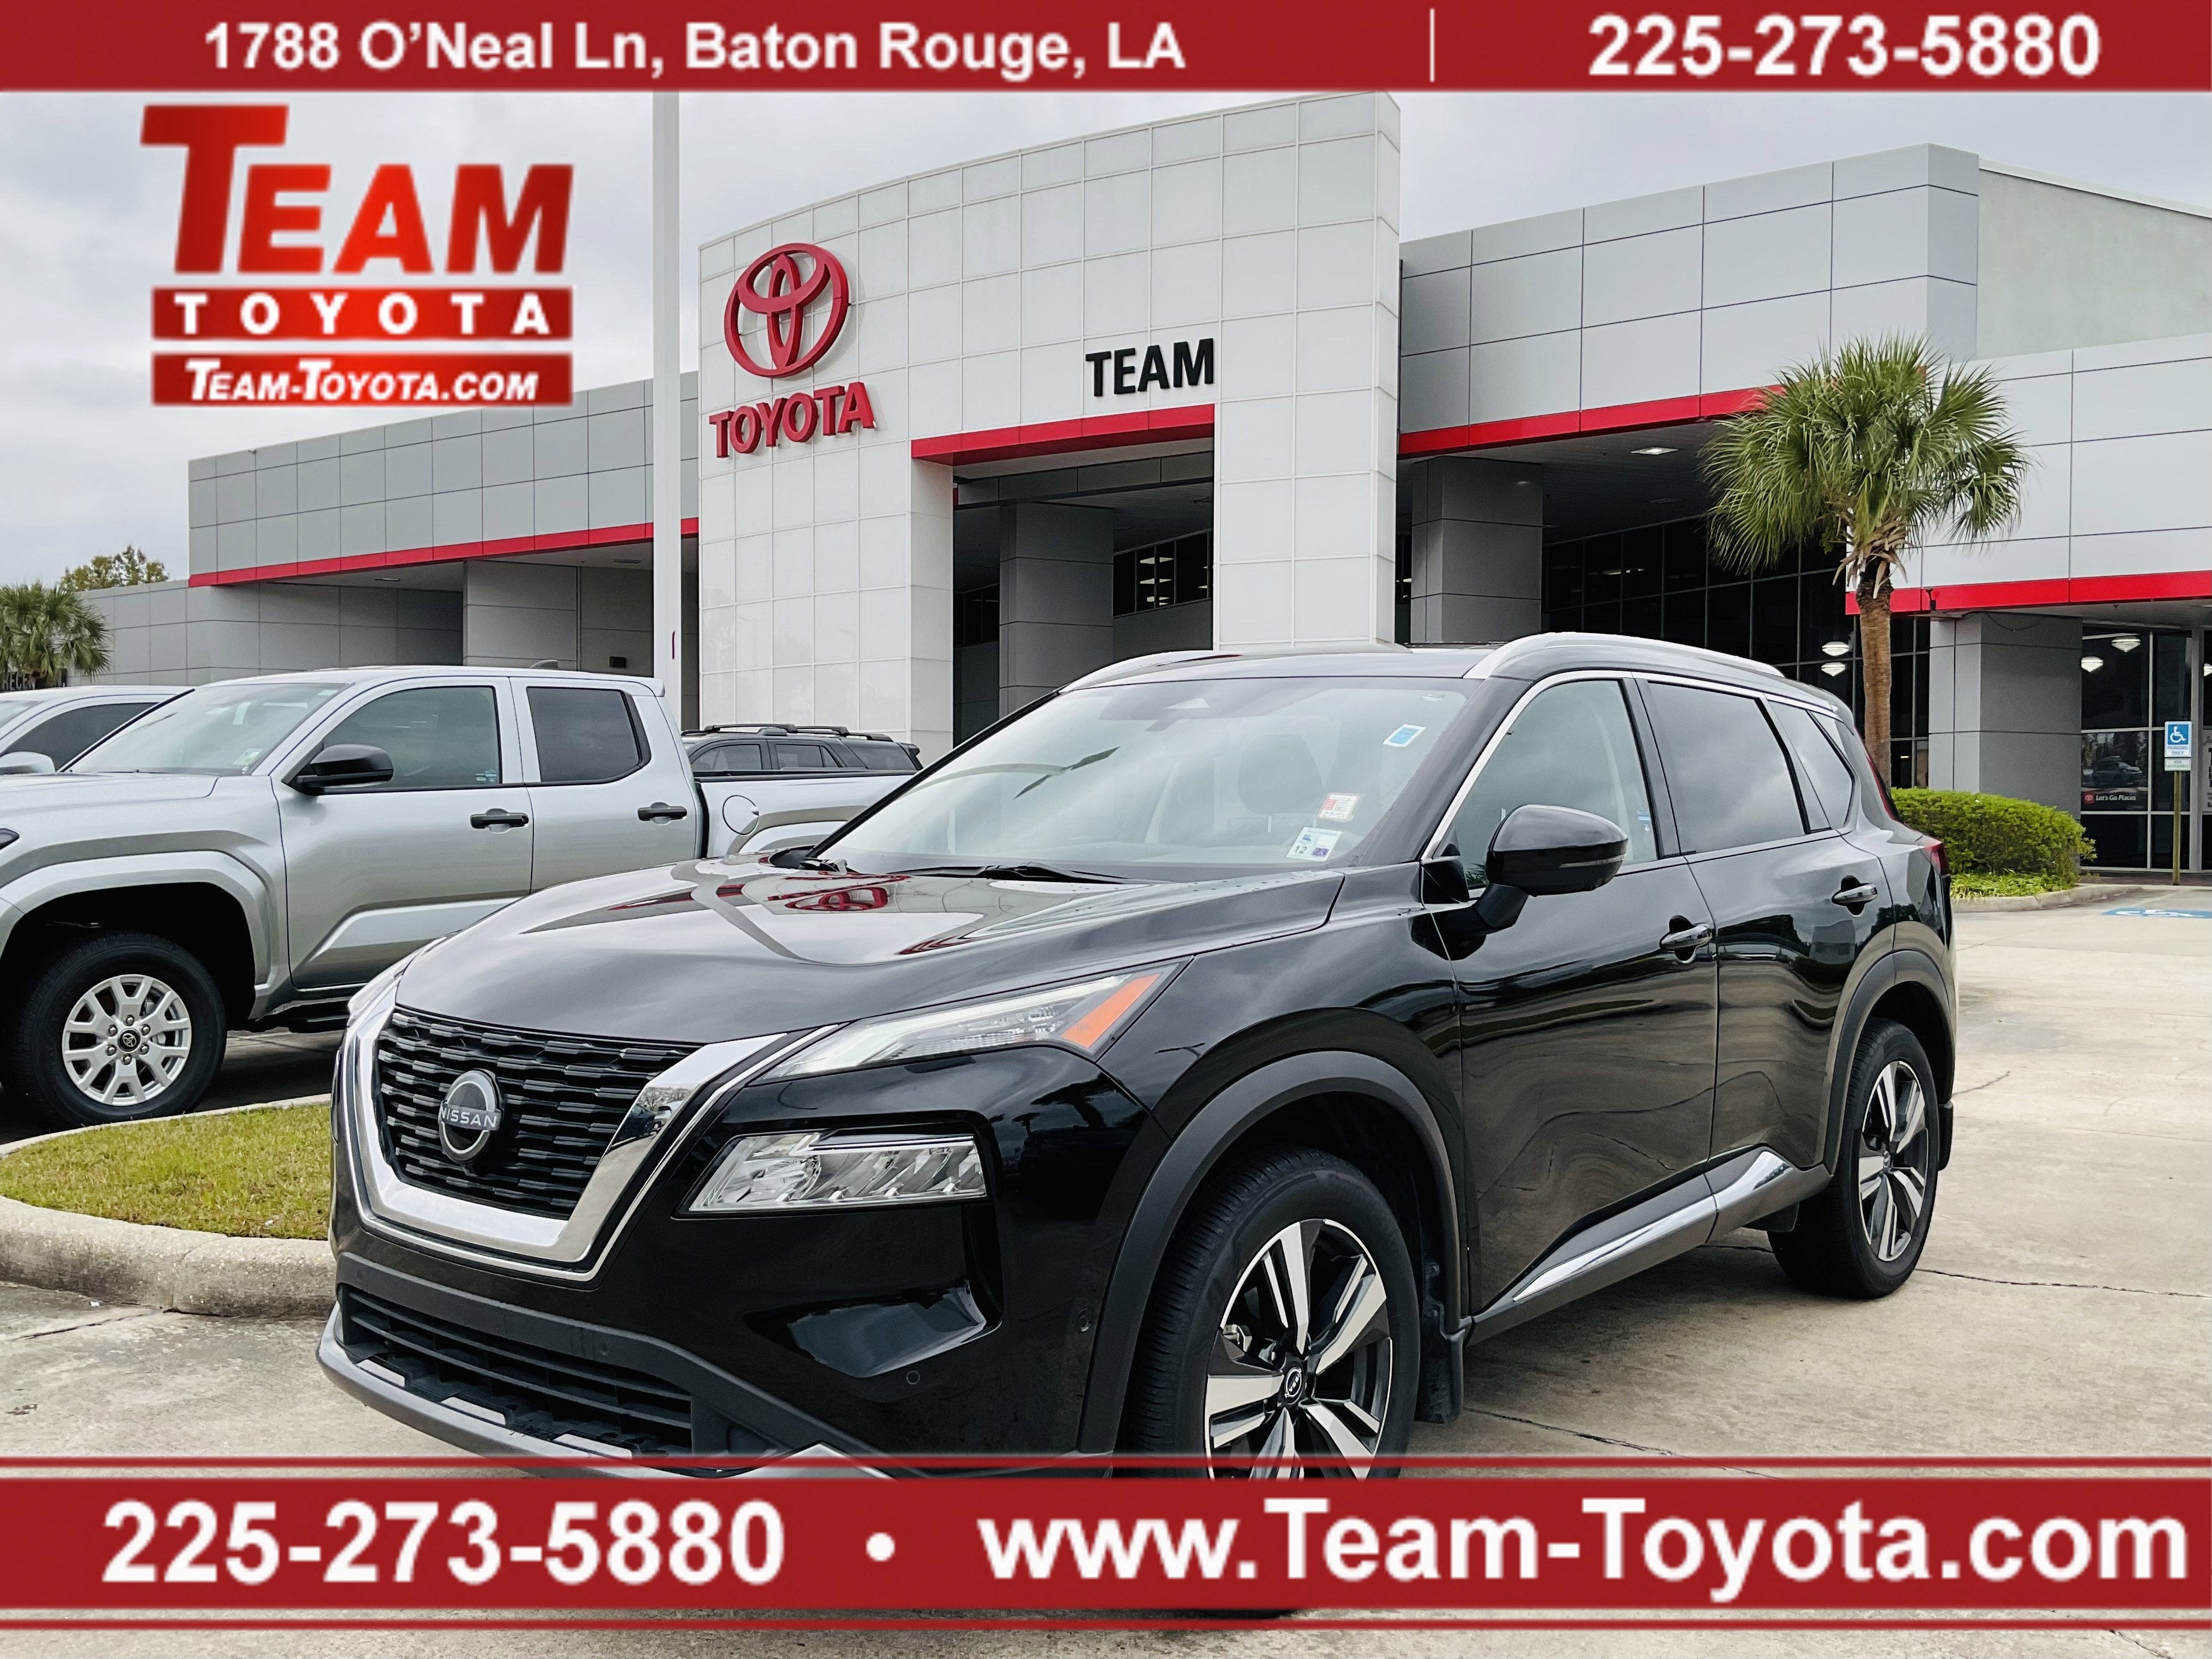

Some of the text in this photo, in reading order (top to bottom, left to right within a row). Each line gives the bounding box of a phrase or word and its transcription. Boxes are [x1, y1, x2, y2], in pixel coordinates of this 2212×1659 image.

[1085, 337, 1214, 398] TEAM
[709, 381, 876, 458] TOYOTA
[1295, 845, 1307, 854] 12
[440, 1105, 497, 1128] NISSAN
